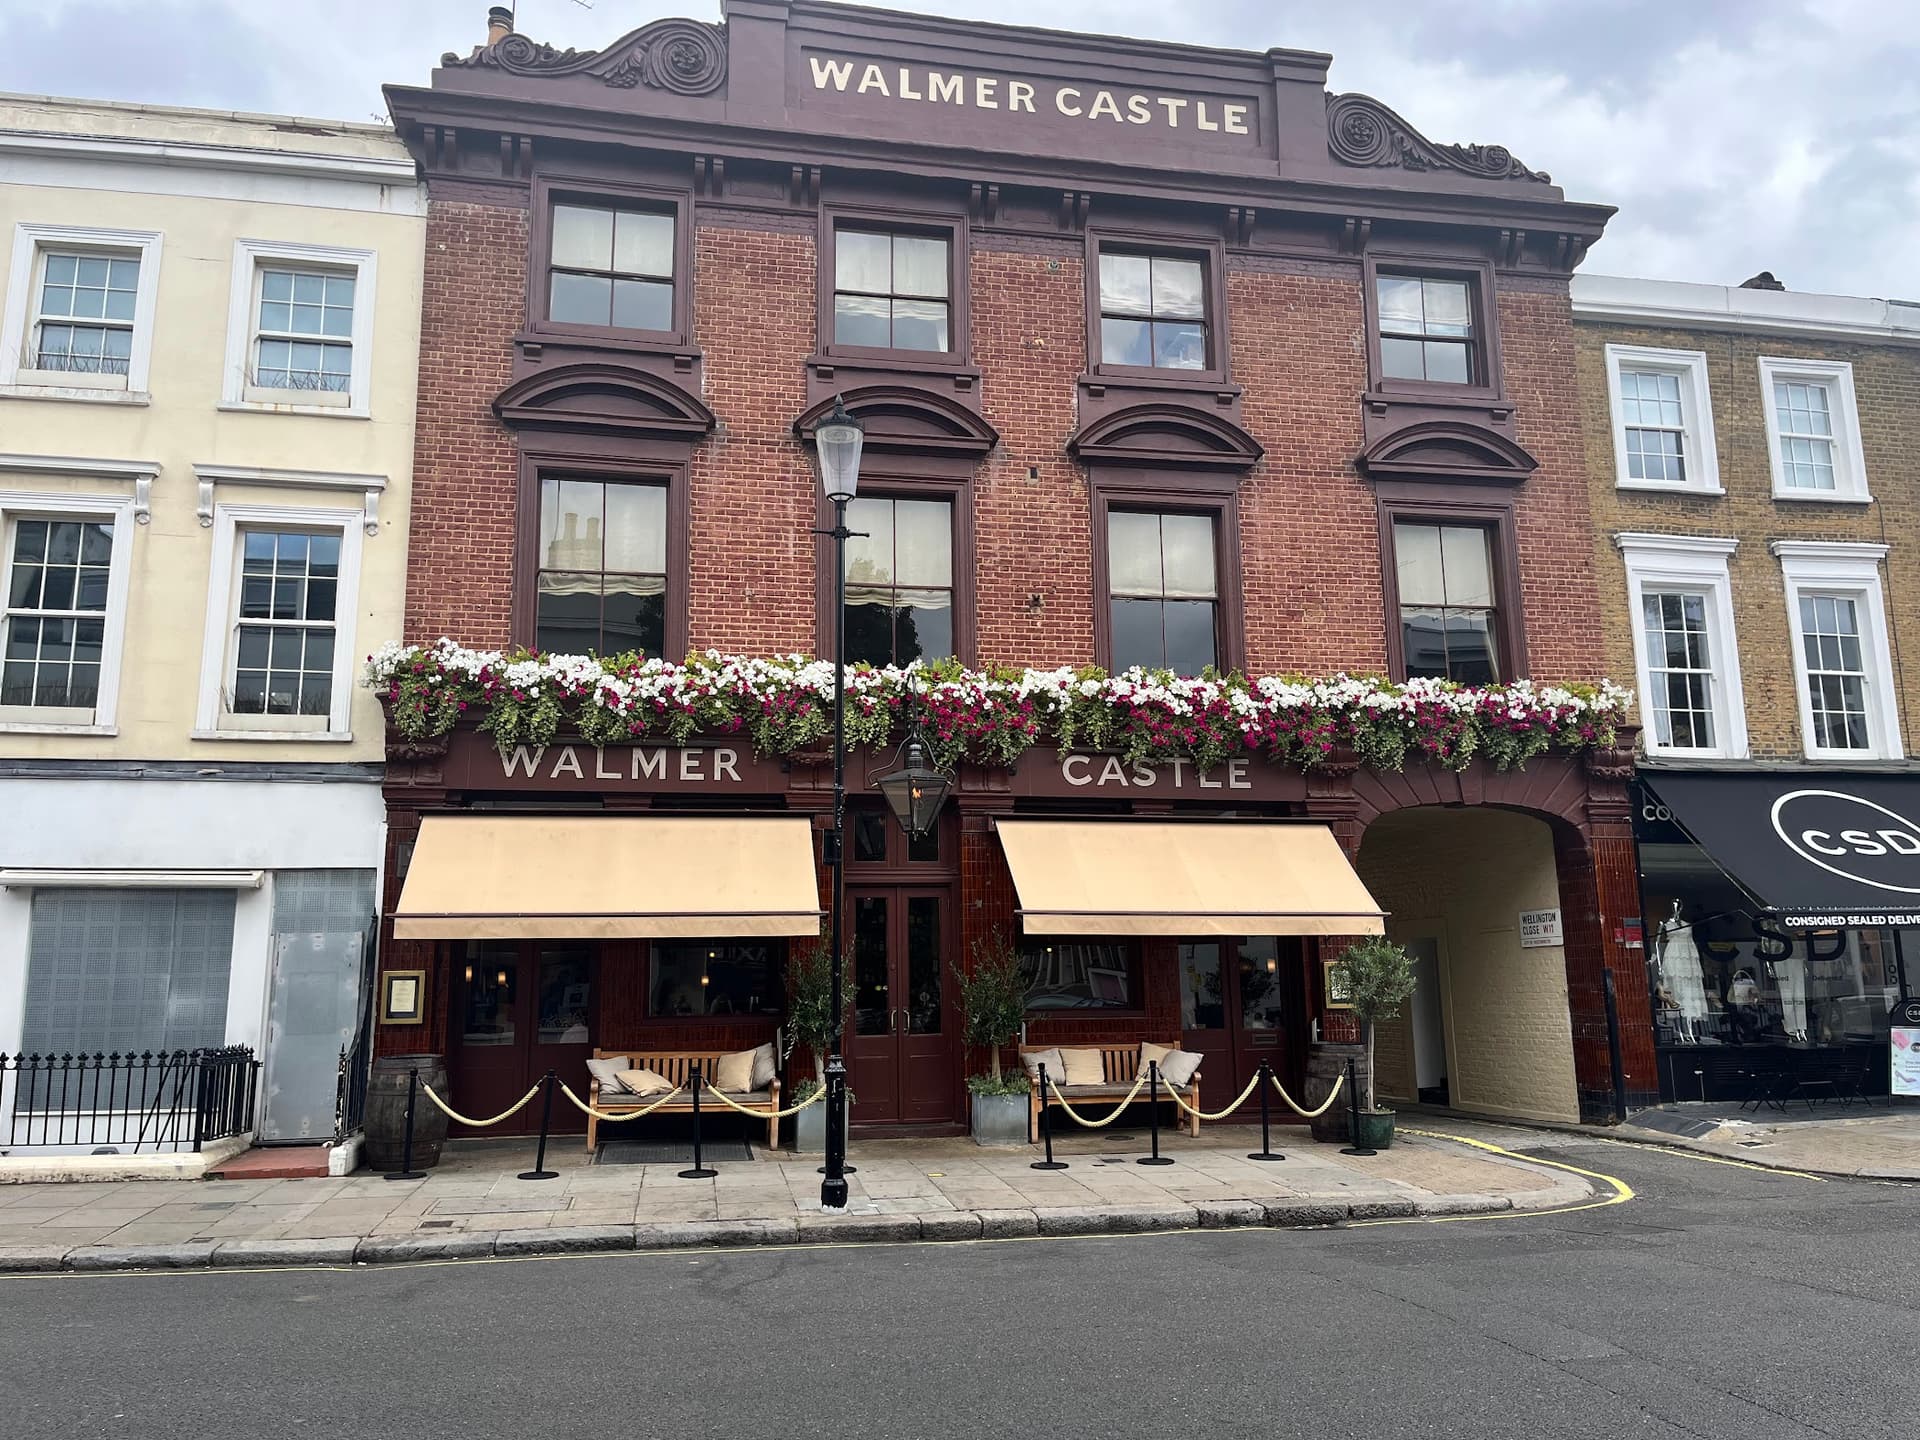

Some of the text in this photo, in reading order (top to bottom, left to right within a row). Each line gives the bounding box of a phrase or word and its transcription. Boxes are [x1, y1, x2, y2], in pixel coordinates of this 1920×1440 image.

[809, 57, 1249, 134] WALMER CASTLE
[499, 745, 742, 782] WALMER
[1062, 754, 1252, 789] CASTLE
[1802, 830, 1920, 855] CSD
[1521, 912, 1556, 925] WELLINGTON
[1522, 923, 1554, 935] CLOSE W11
[1785, 916, 1846, 926] CONSIGNED
[1848, 916, 1886, 926] SEALED
